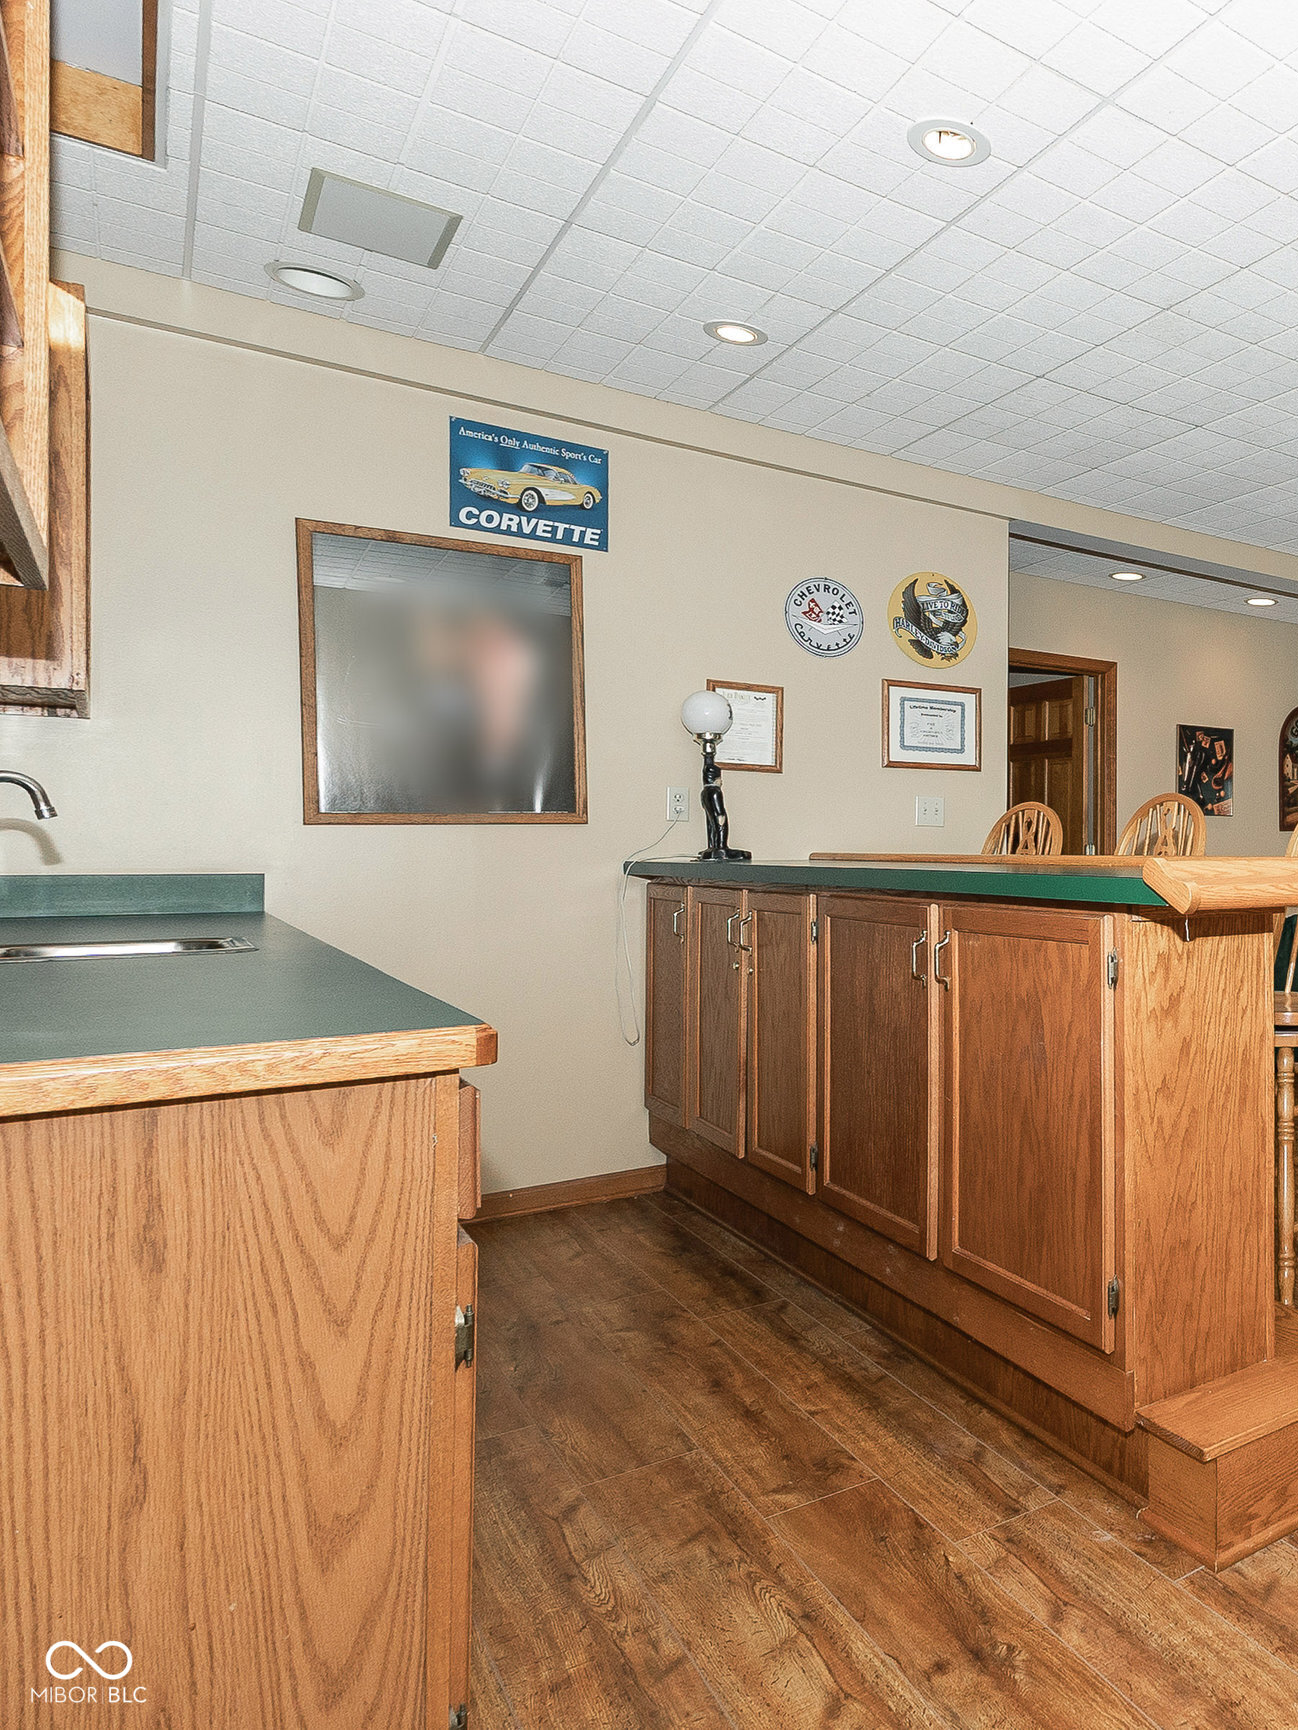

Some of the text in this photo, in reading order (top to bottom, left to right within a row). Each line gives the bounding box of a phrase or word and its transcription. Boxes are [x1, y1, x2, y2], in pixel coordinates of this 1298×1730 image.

[459, 426, 602, 465] America's Only Authentic Sport's Car
[458, 506, 600, 546] CORVETTE
[793, 583, 858, 616] CHEVROLET
[939, 600, 949, 609] TO
[794, 622, 855, 652] Corvette
